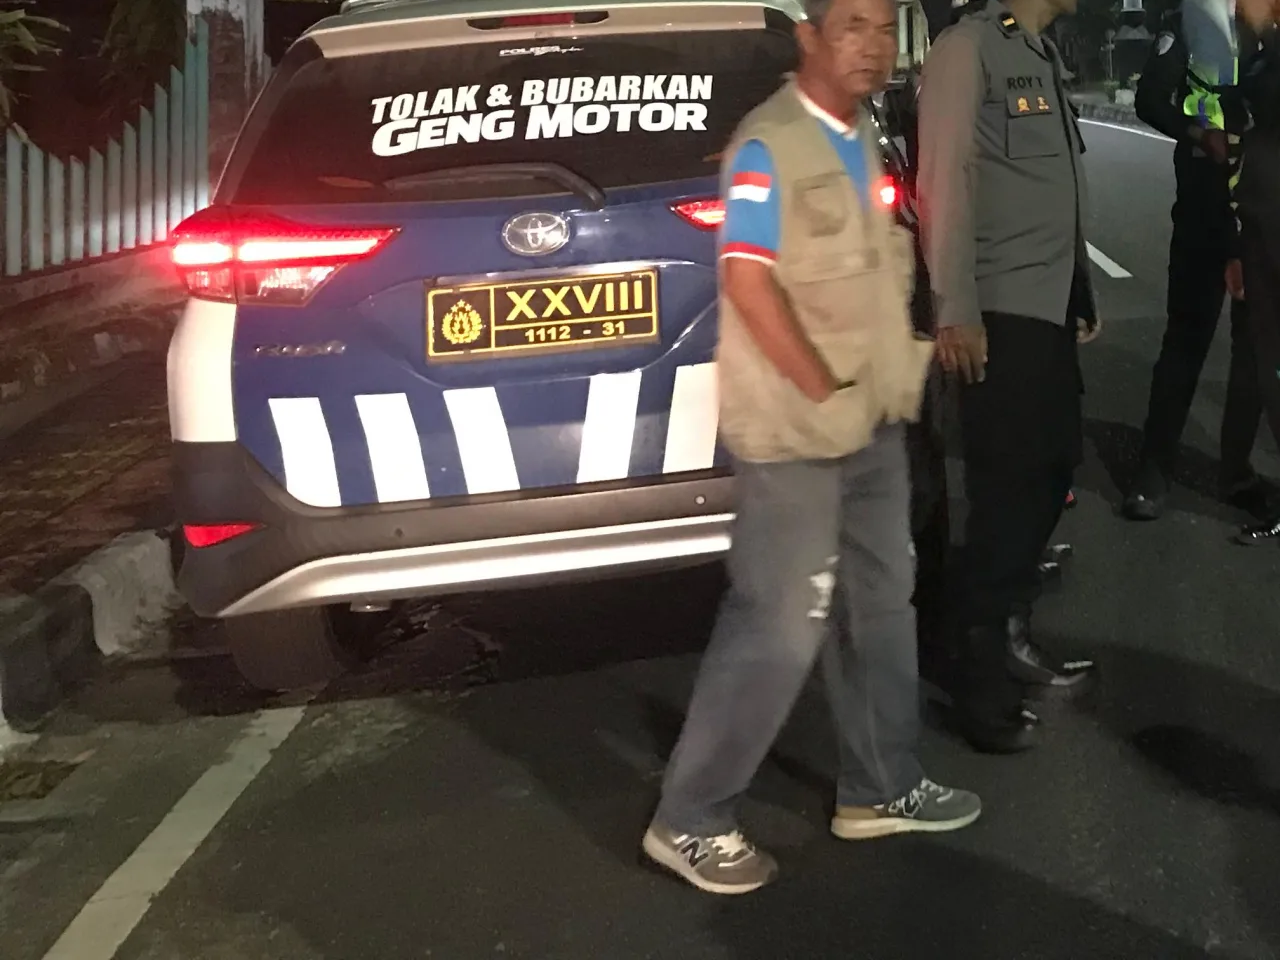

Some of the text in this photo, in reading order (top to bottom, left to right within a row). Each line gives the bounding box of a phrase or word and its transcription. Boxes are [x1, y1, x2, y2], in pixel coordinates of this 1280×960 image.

[371, 74, 713, 124] TOLAK & BUBARKAN
[1006, 76, 1033, 90] ROY
[371, 101, 708, 157] GENG MOTOR
[505, 280, 643, 321] XXVIII
[524, 325, 571, 342] 1112
[602, 320, 625, 335] 31
[680, 840, 709, 868] N
